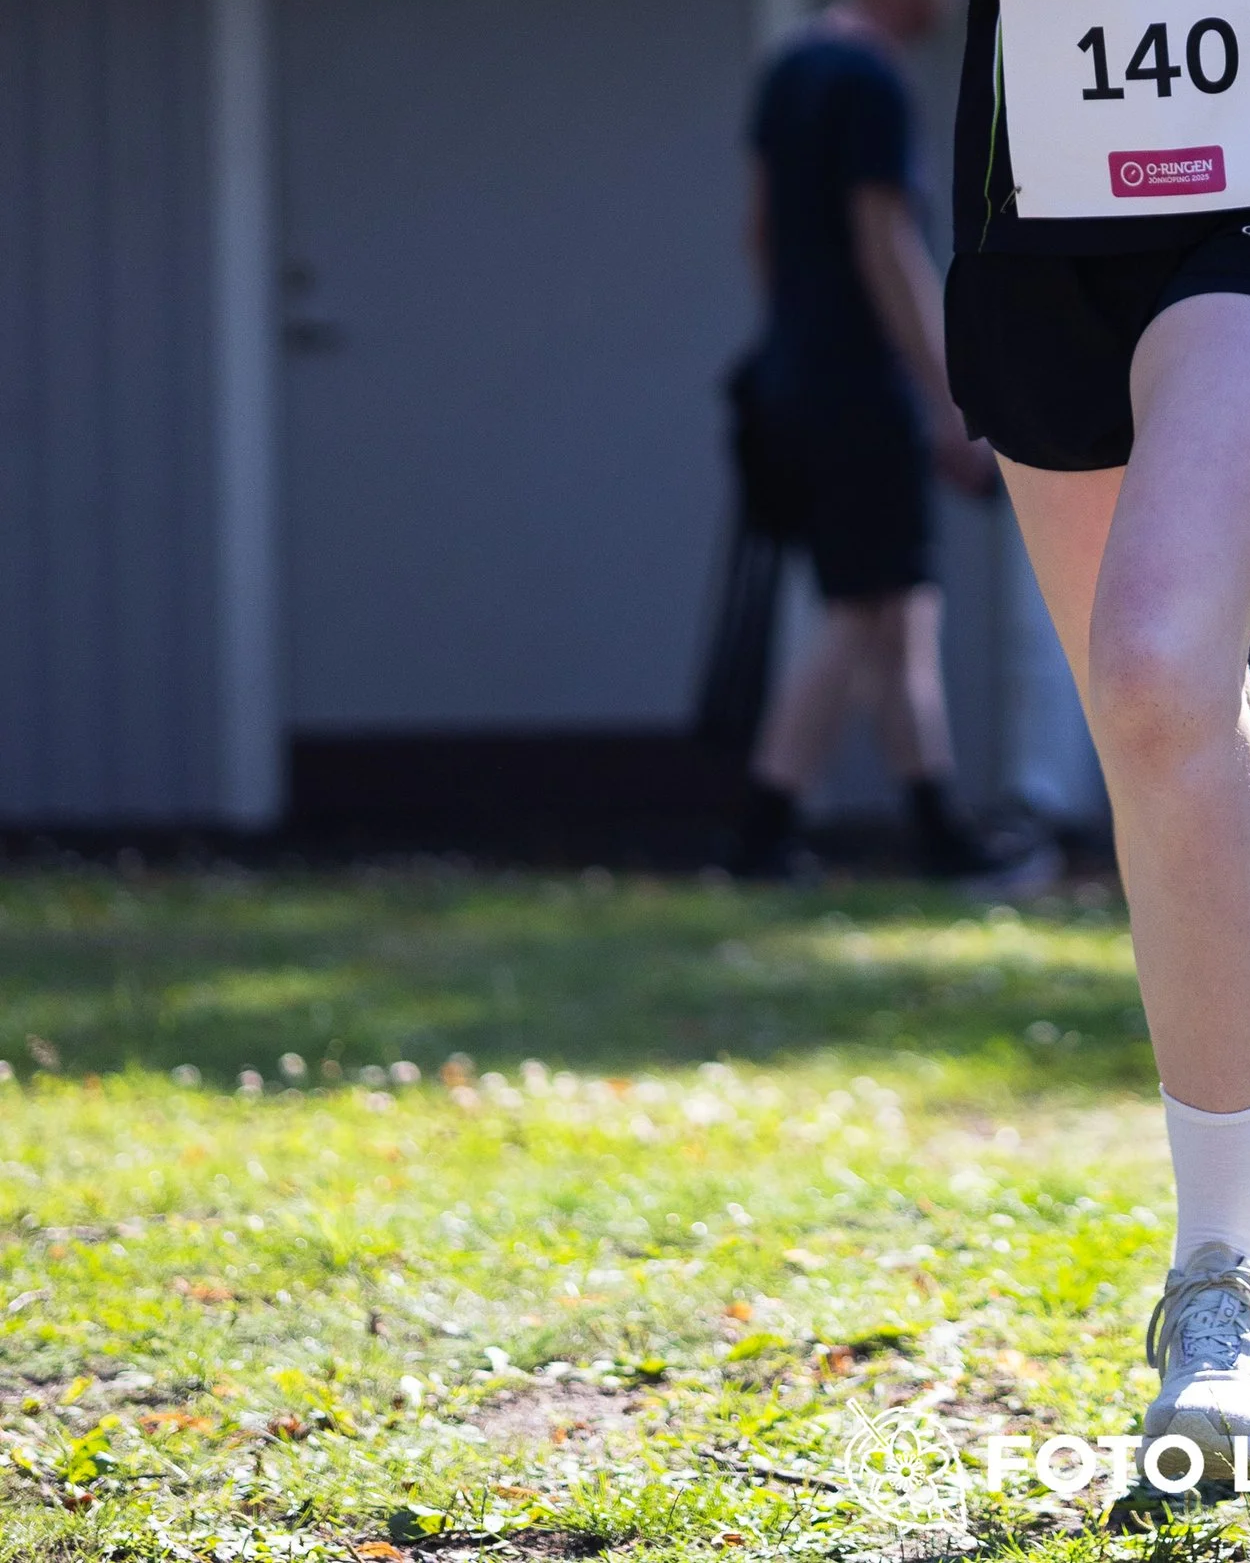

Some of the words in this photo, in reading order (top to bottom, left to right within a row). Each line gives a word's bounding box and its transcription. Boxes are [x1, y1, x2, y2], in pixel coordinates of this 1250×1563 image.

[1077, 17, 1239, 100] 140
[1146, 159, 1213, 176] O-RINGEN
[1191, 173, 1210, 183] 2025
